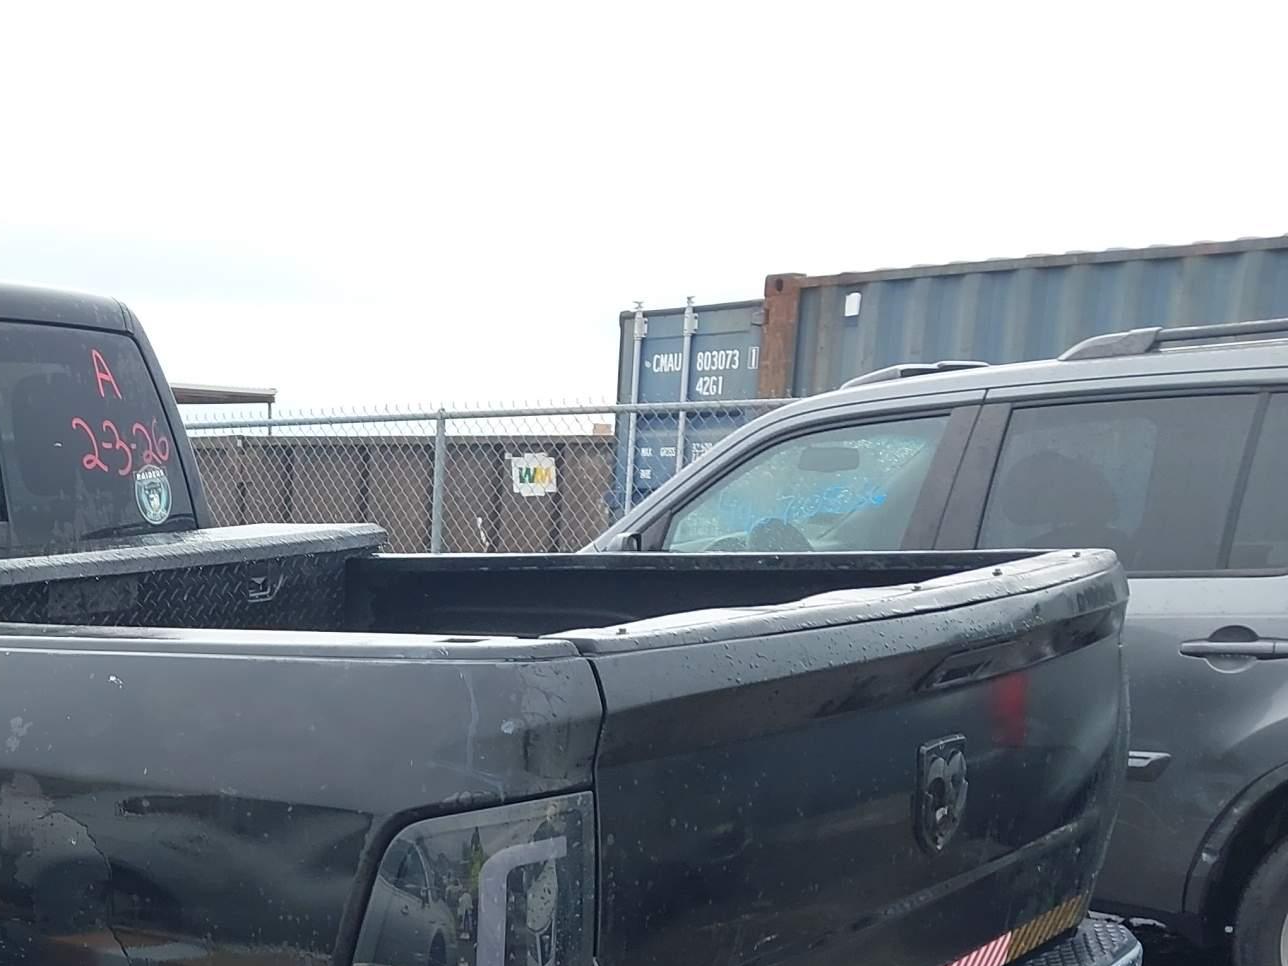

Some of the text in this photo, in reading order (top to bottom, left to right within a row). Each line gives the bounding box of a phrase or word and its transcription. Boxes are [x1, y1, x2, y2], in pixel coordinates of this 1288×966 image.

[652, 352, 683, 373] CMAU
[695, 349, 741, 372] 803073
[91, 349, 122, 399] A
[695, 375, 724, 396] 42G1
[71, 417, 170, 476] 2-3-26
[518, 466, 553, 484] WM
